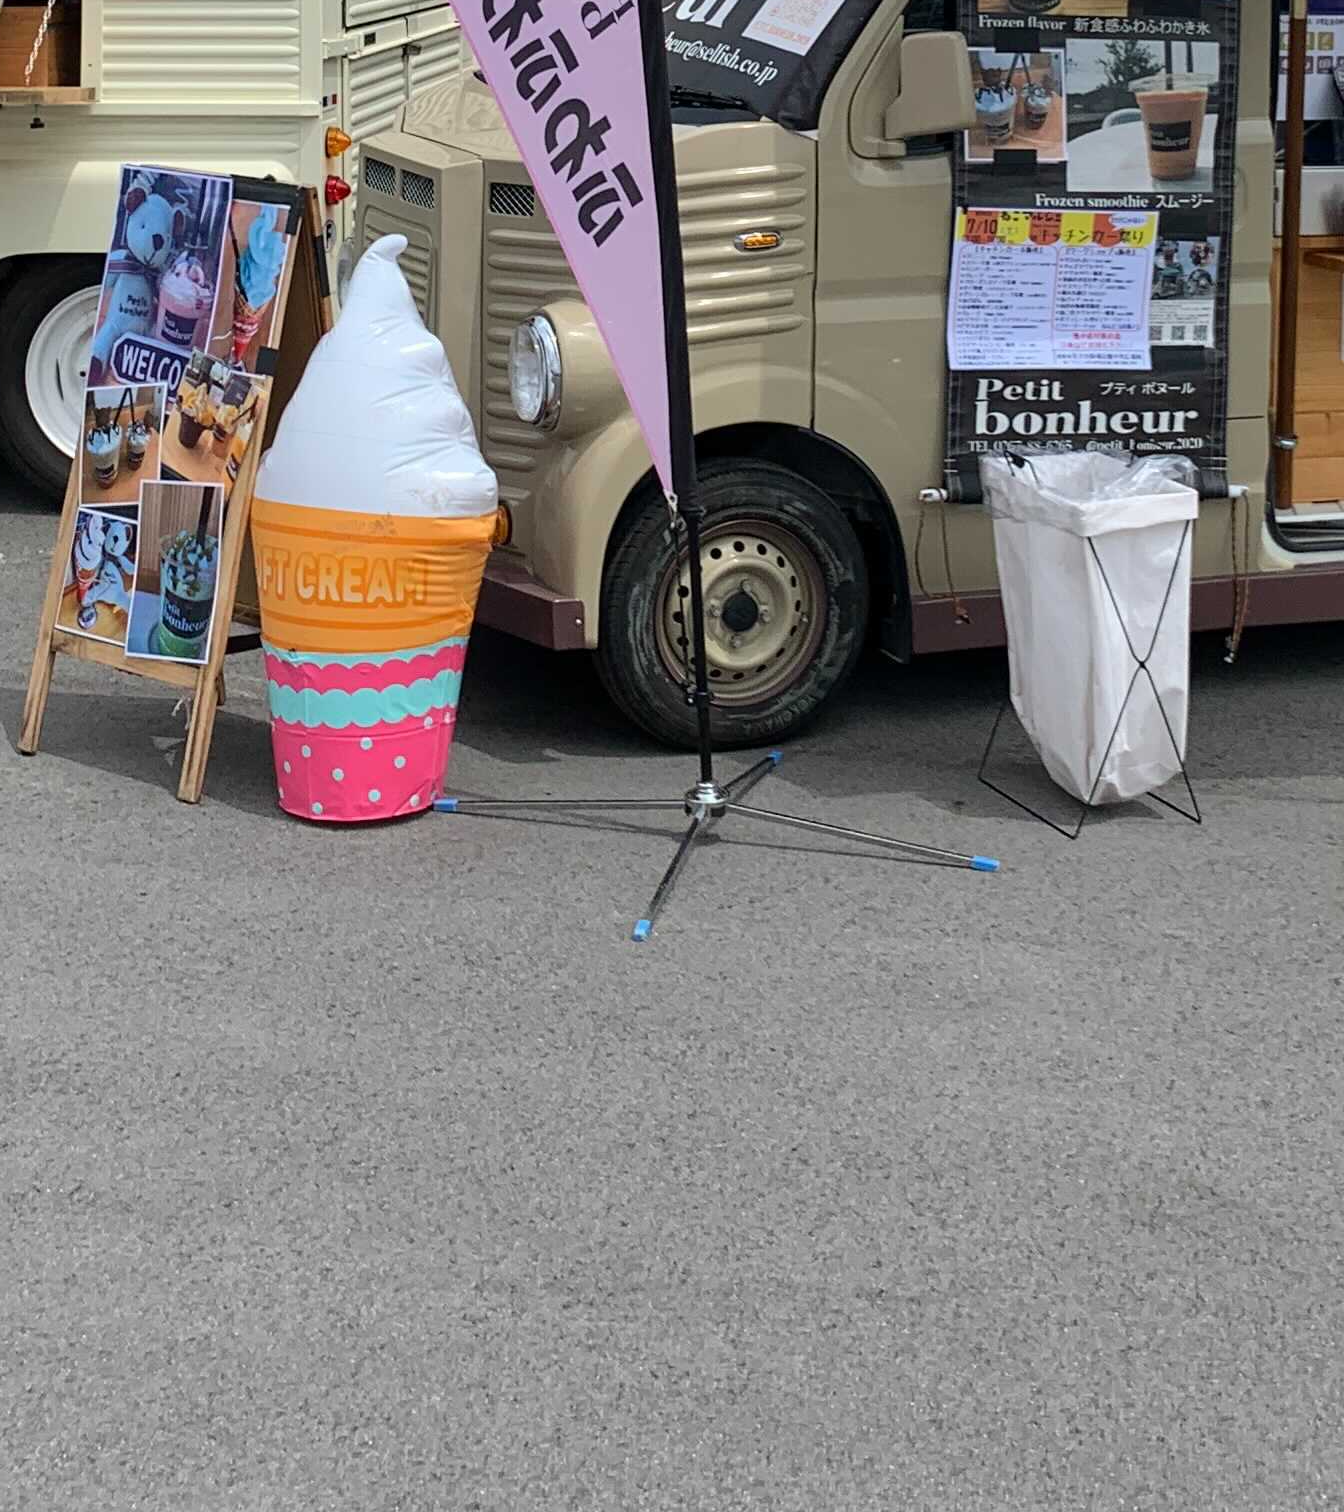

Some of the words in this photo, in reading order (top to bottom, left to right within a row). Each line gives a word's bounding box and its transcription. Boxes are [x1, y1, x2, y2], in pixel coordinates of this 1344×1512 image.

[978, 15, 1025, 29] Frozen
[1027, 15, 1066, 31] flavor
[1073, 17, 1212, 36] 新食感ふわふわかき氷
[1035, 193, 1085, 208] Frozen
[1087, 194, 1148, 209] smoothie
[1155, 194, 1215, 209] スムージー
[966, 218, 998, 235] 7/10
[975, 378, 1064, 401] Petit
[1099, 382, 1136, 396] プティ
[1141, 382, 1197, 396] ボヌール
[974, 400, 1200, 436] bonheur
